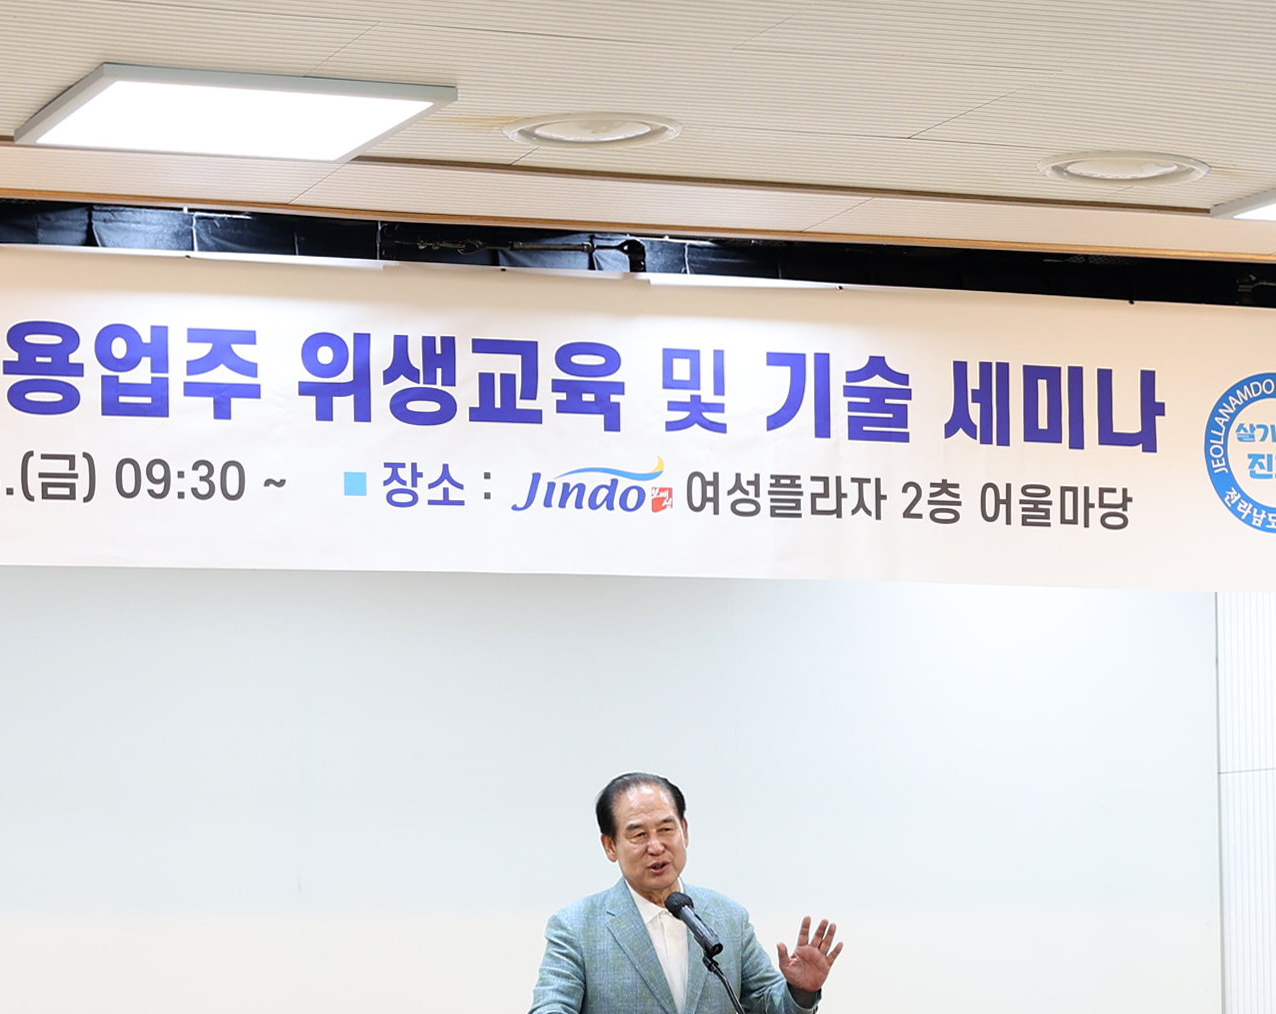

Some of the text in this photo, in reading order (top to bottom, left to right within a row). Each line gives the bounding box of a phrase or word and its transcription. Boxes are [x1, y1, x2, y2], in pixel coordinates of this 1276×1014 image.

[297, 331, 625, 433] 위생교육
[662, 348, 727, 434] 및
[766, 351, 913, 444] 기술
[943, 360, 1166, 454] 세미나
[1209, 378, 1275, 474] JEOLLANAMDO
[115, 457, 246, 501] 09:30
[383, 462, 465, 508] 장소
[511, 472, 646, 512] Jindo
[686, 471, 888, 521] 여성플라자
[901, 478, 962, 525] 2층
[980, 482, 1133, 531] 어울마당
